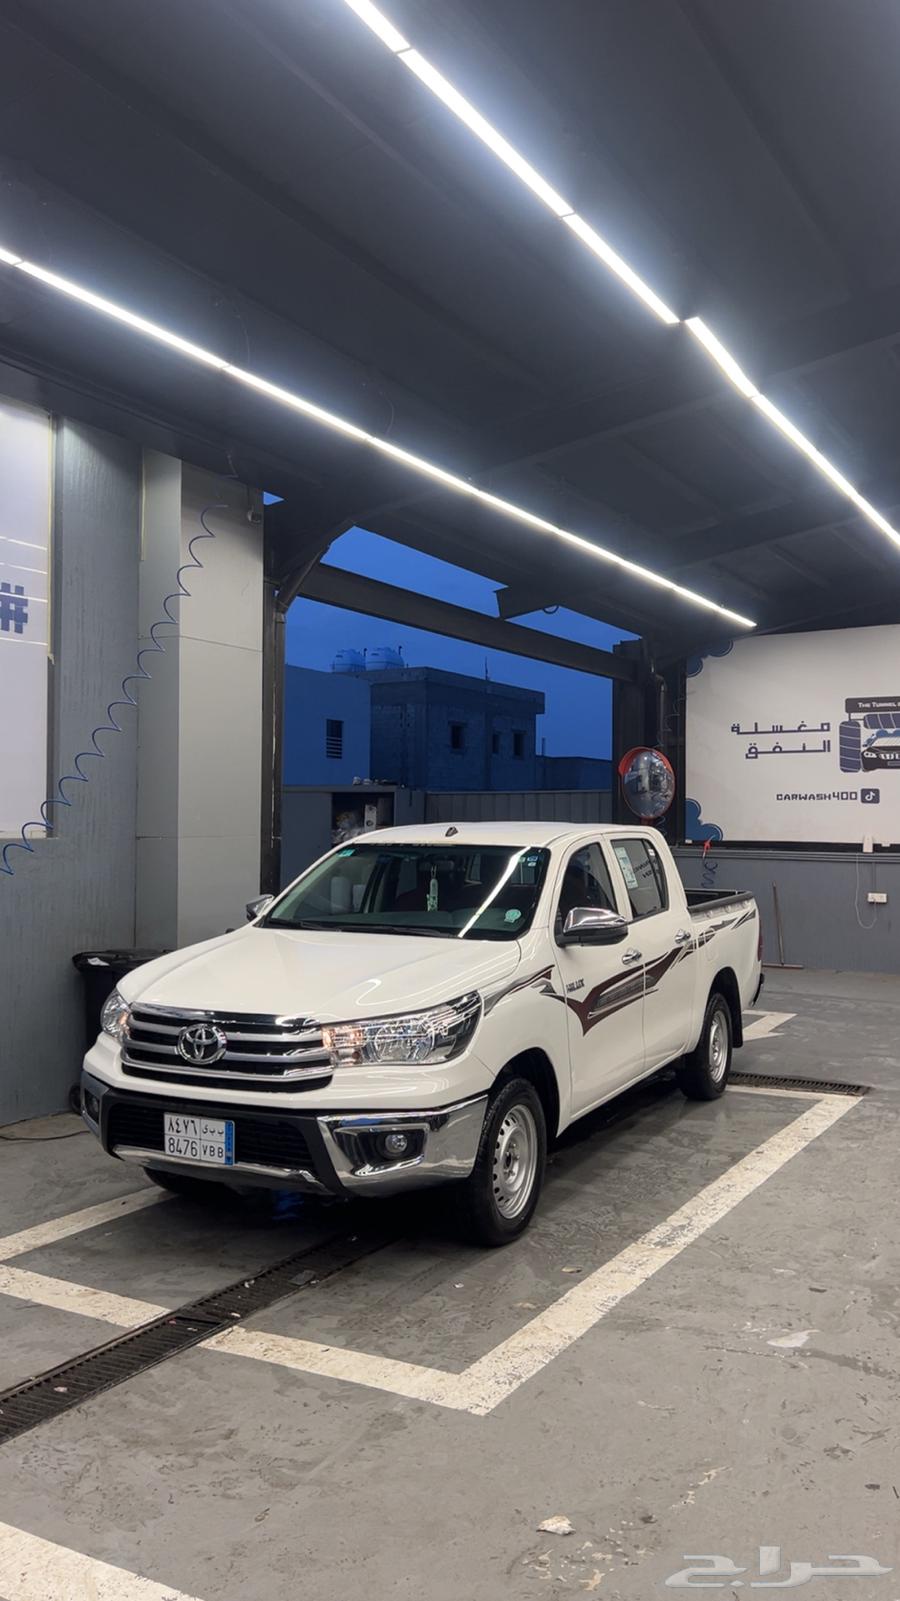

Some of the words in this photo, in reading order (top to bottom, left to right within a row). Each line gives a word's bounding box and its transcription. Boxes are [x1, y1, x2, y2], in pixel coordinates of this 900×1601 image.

[731, 720, 830, 735] مغسلة
[745, 740, 830, 759] النفق
[776, 791, 858, 801] CARWASH400
[168, 1137, 198, 1157] 8476
[202, 1144, 224, 1158] VBB
